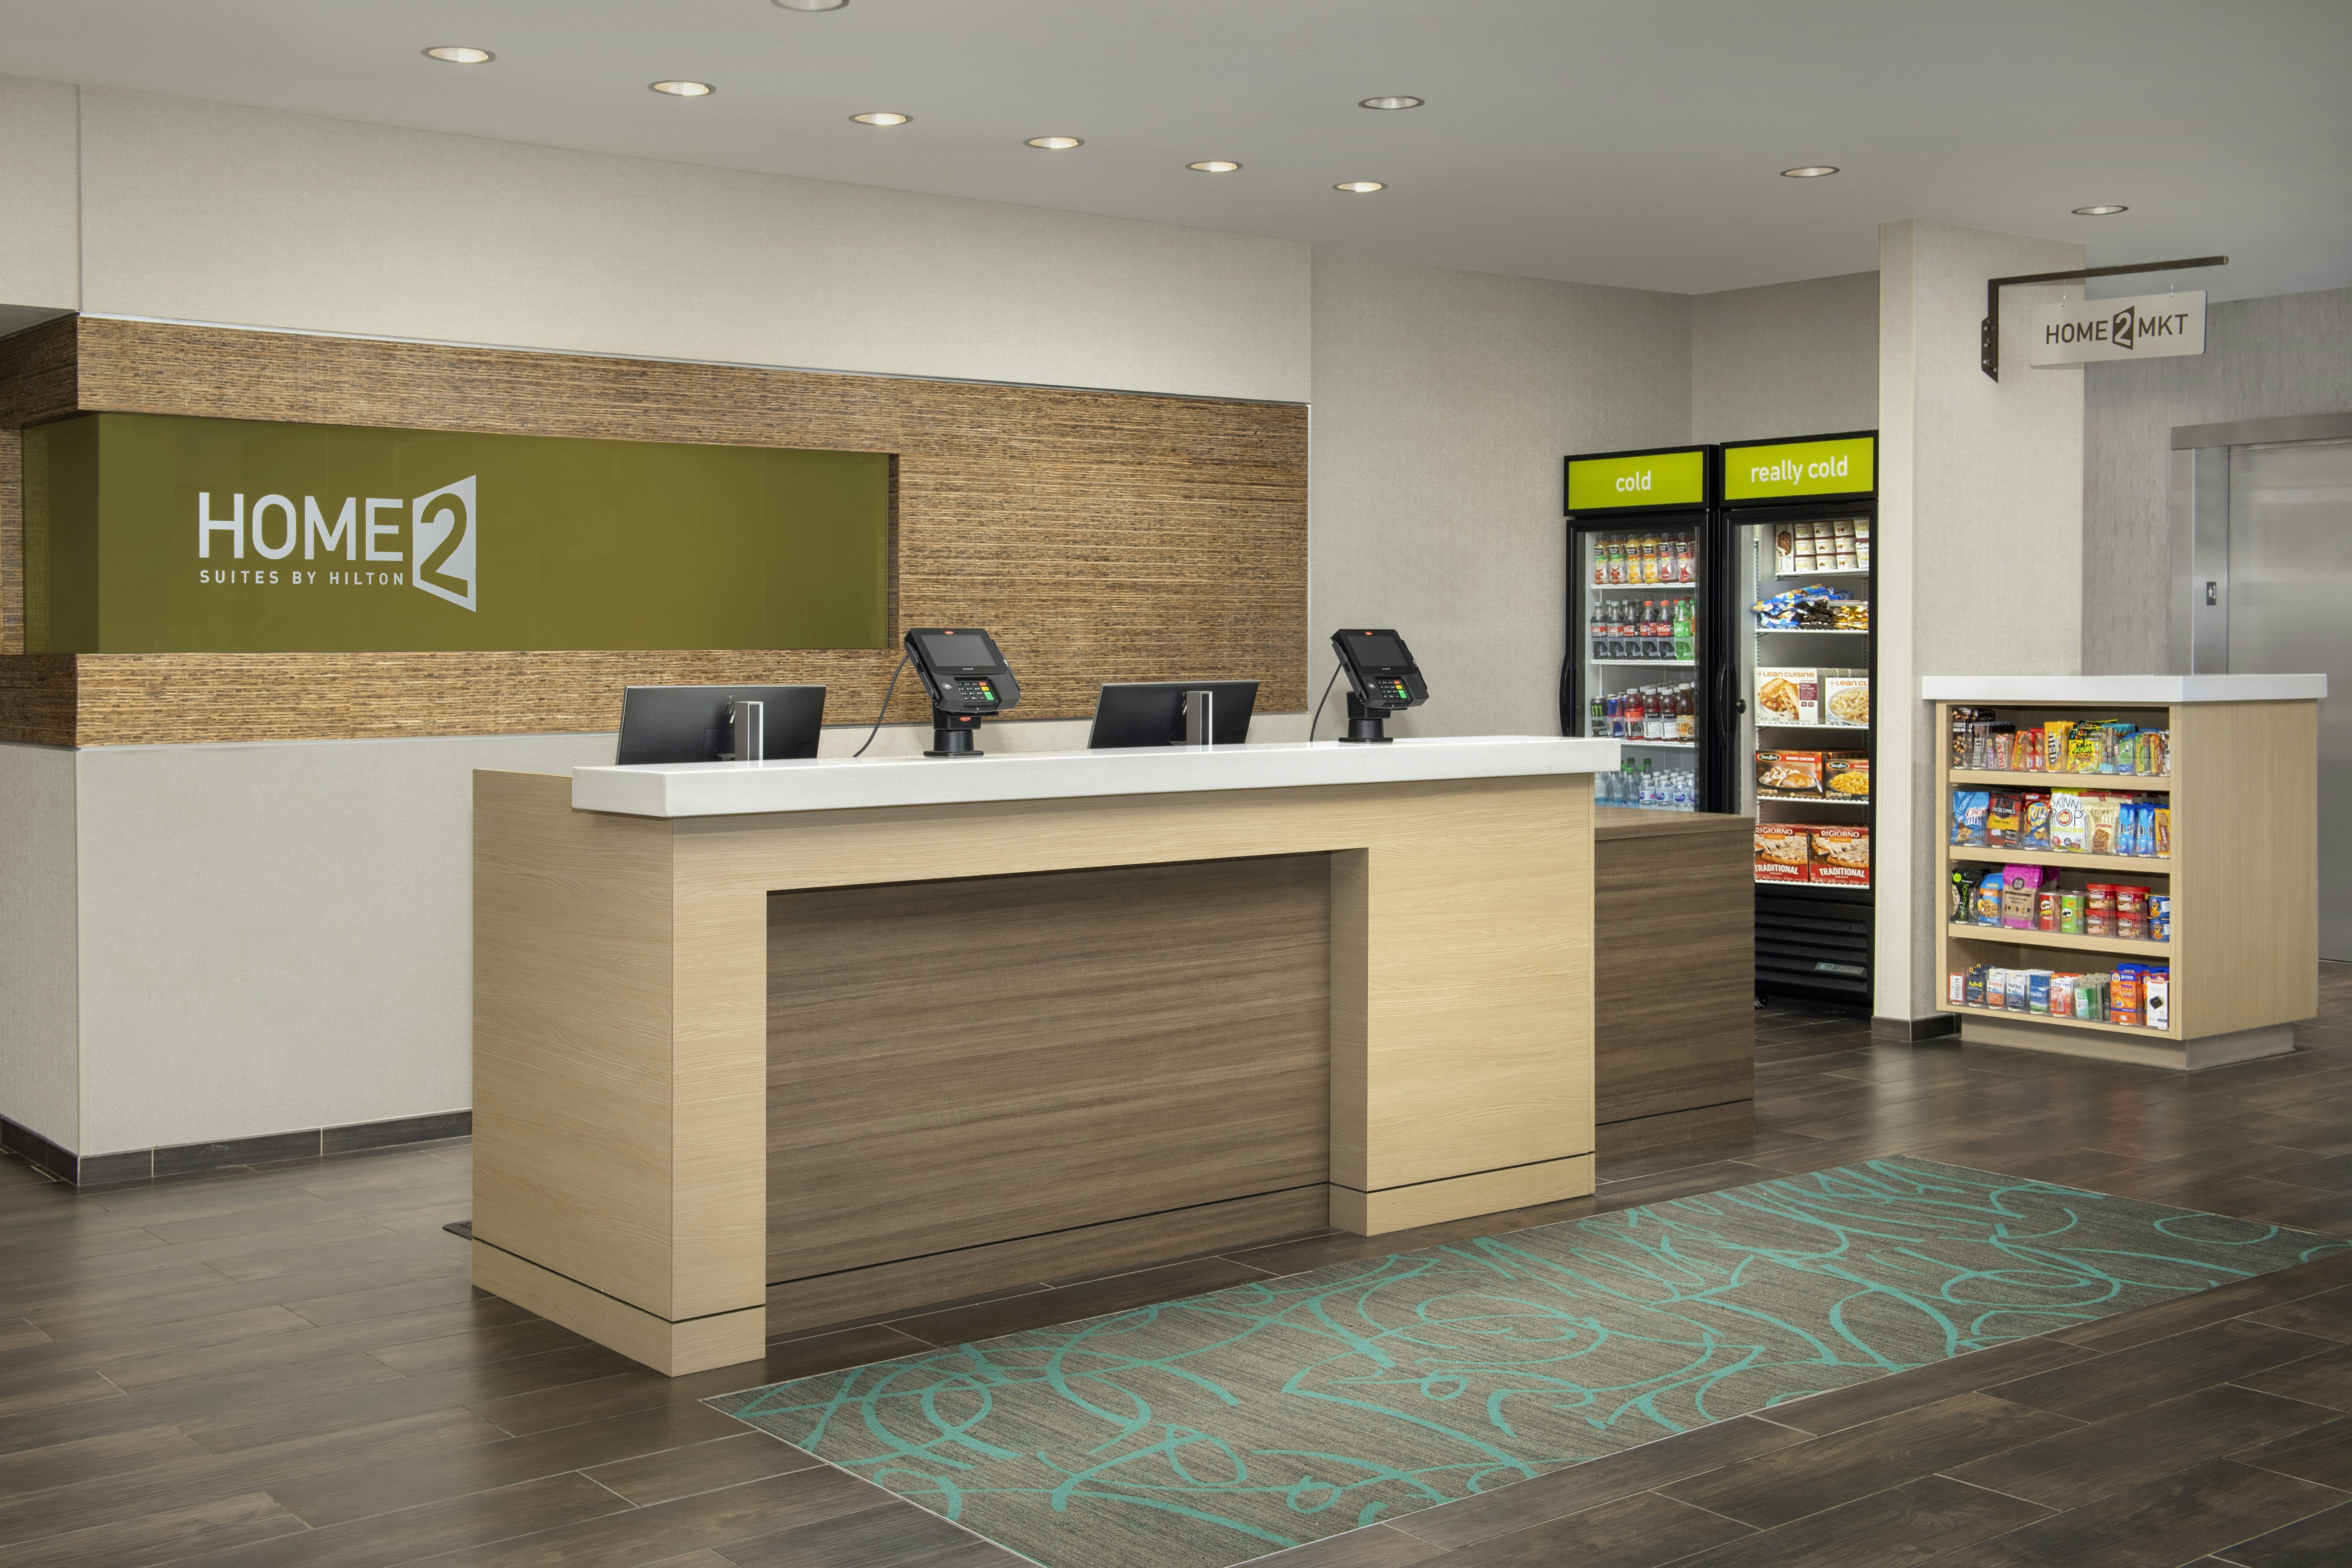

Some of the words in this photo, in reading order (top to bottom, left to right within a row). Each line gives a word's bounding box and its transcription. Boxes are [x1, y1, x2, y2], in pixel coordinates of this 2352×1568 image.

[2046, 320, 2108, 344] HOME
[2138, 314, 2189, 338] MKT
[1616, 471, 1652, 492] cold
[1751, 460, 1803, 485] really
[1808, 455, 1848, 479] cold
[200, 570, 279, 584] SUITES
[292, 572, 316, 584] BY
[329, 572, 403, 585] HILTON
[1973, 737, 1982, 767] HERSHEY'S
[1997, 743, 2007, 769] TWIX
[1966, 807, 1987, 818] Chex
[2028, 805, 2047, 820] RITZ
[1818, 868, 1865, 878] TRADITIONAL
[1960, 883, 1969, 919] PISTACHIOS
